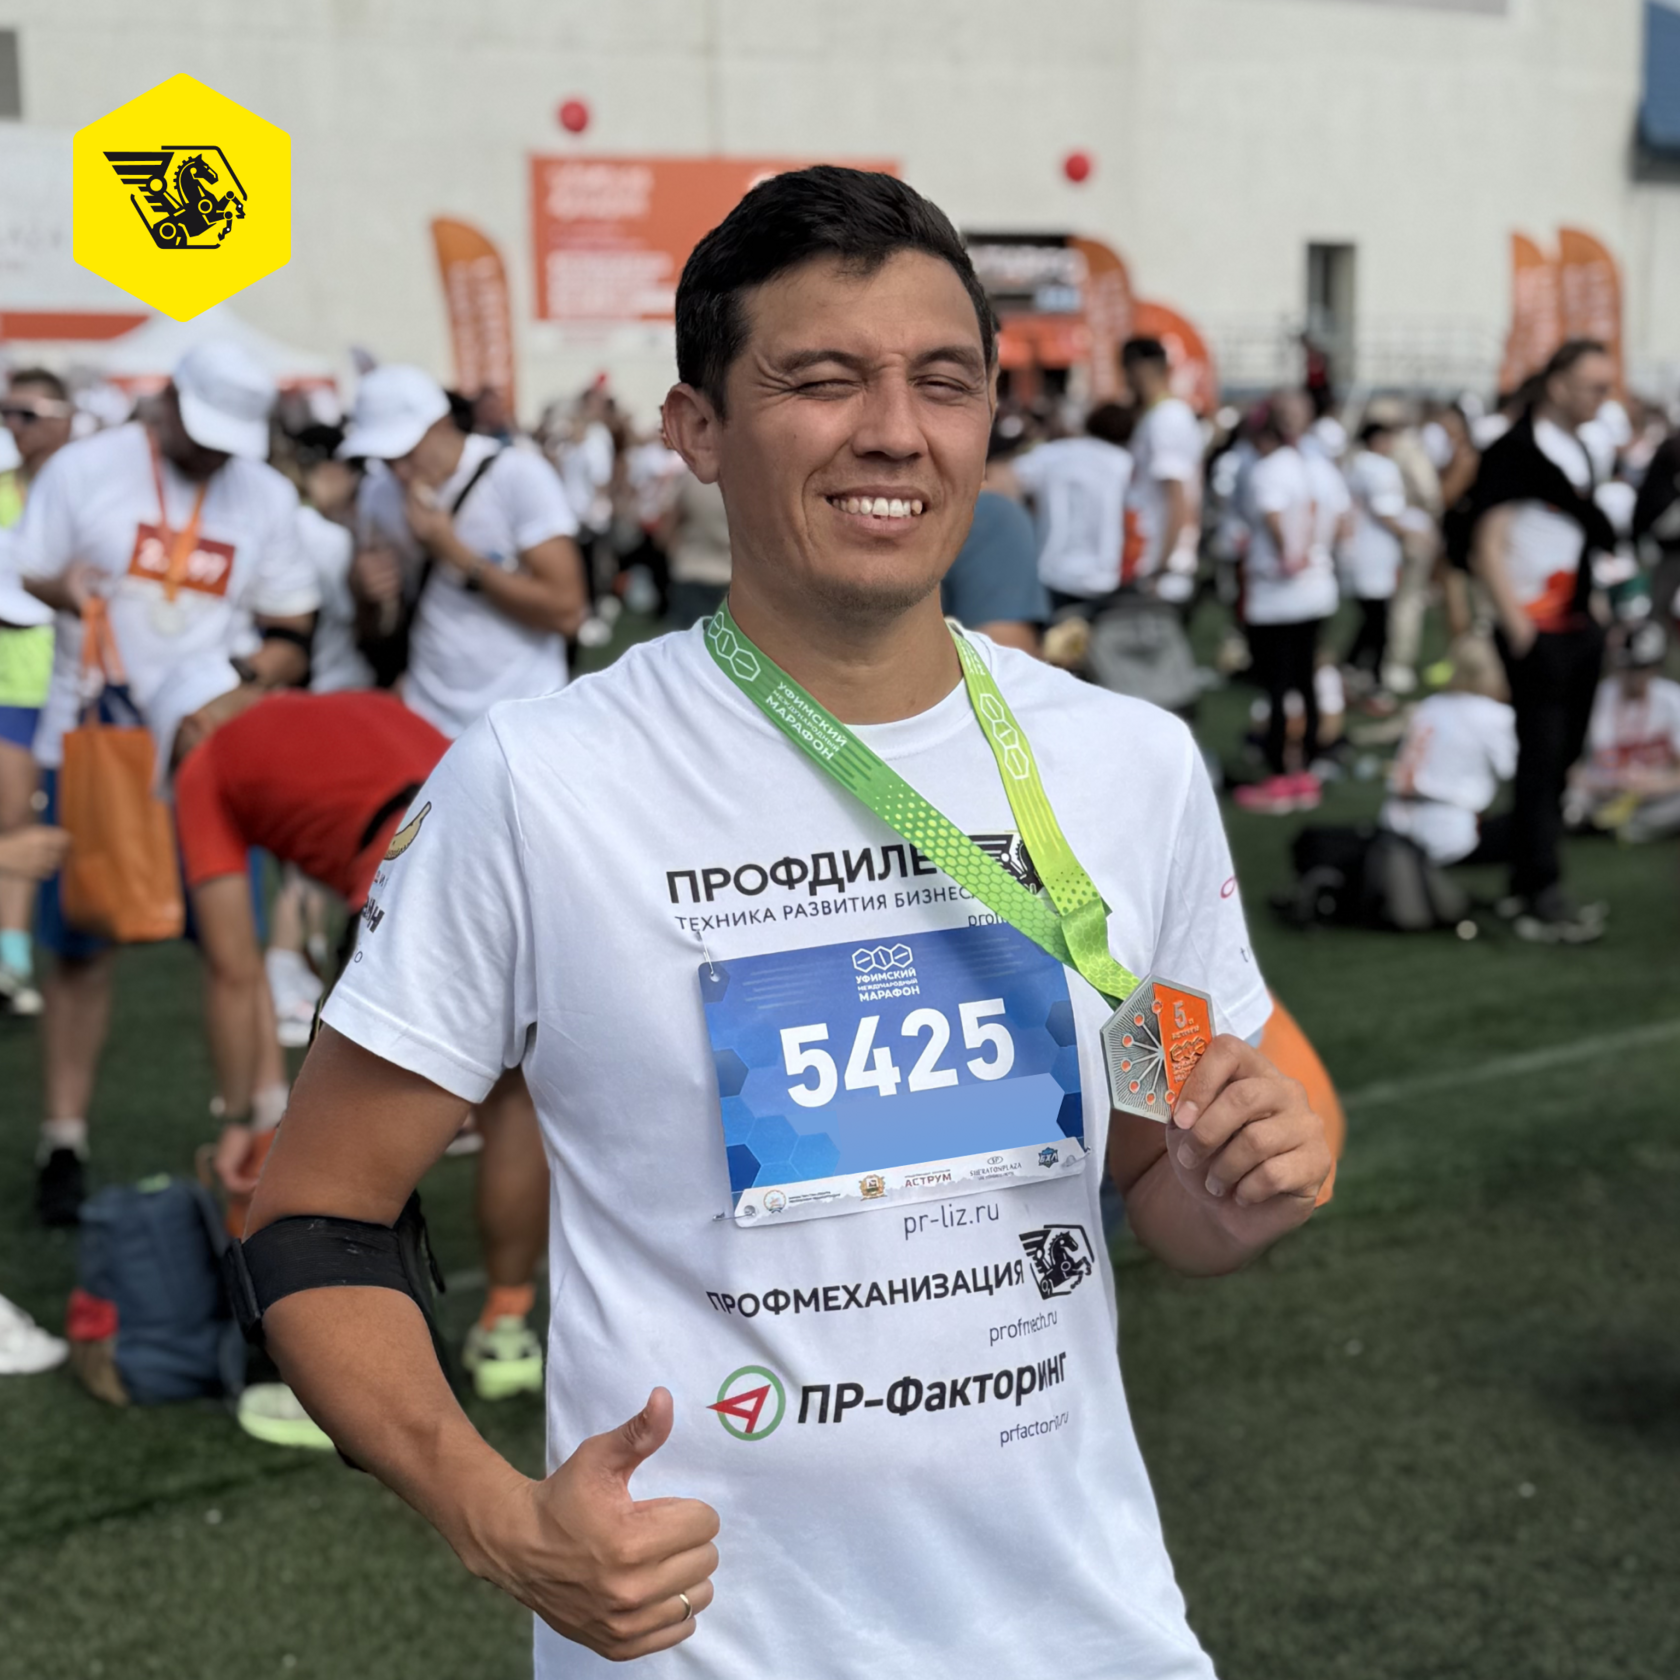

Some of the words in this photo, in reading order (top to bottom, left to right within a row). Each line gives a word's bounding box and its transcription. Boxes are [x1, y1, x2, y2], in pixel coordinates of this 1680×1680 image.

[765, 695, 834, 760] МАРАФОН
[777, 681, 847, 747] УФИМСКИЙ
[666, 841, 942, 904] ПРОФДИЛЕ
[674, 907, 777, 932] ТЕХНИКА
[782, 894, 888, 921] РАЗВИТИЯ
[894, 885, 976, 908] БИЗНЕС
[855, 967, 917, 985] УФИМСКИЙ
[859, 985, 920, 1002] МАРАФОН
[1173, 1000, 1188, 1029] 5
[779, 997, 1015, 1108] 5425
[905, 1172, 952, 1188] АСТРУМ
[903, 1201, 1000, 1239] pr-liz.ru
[706, 1259, 1025, 1318] ПРОФМЕХАНИЗАЦИЯ
[797, 1351, 1067, 1424] ПР-Факторинг
